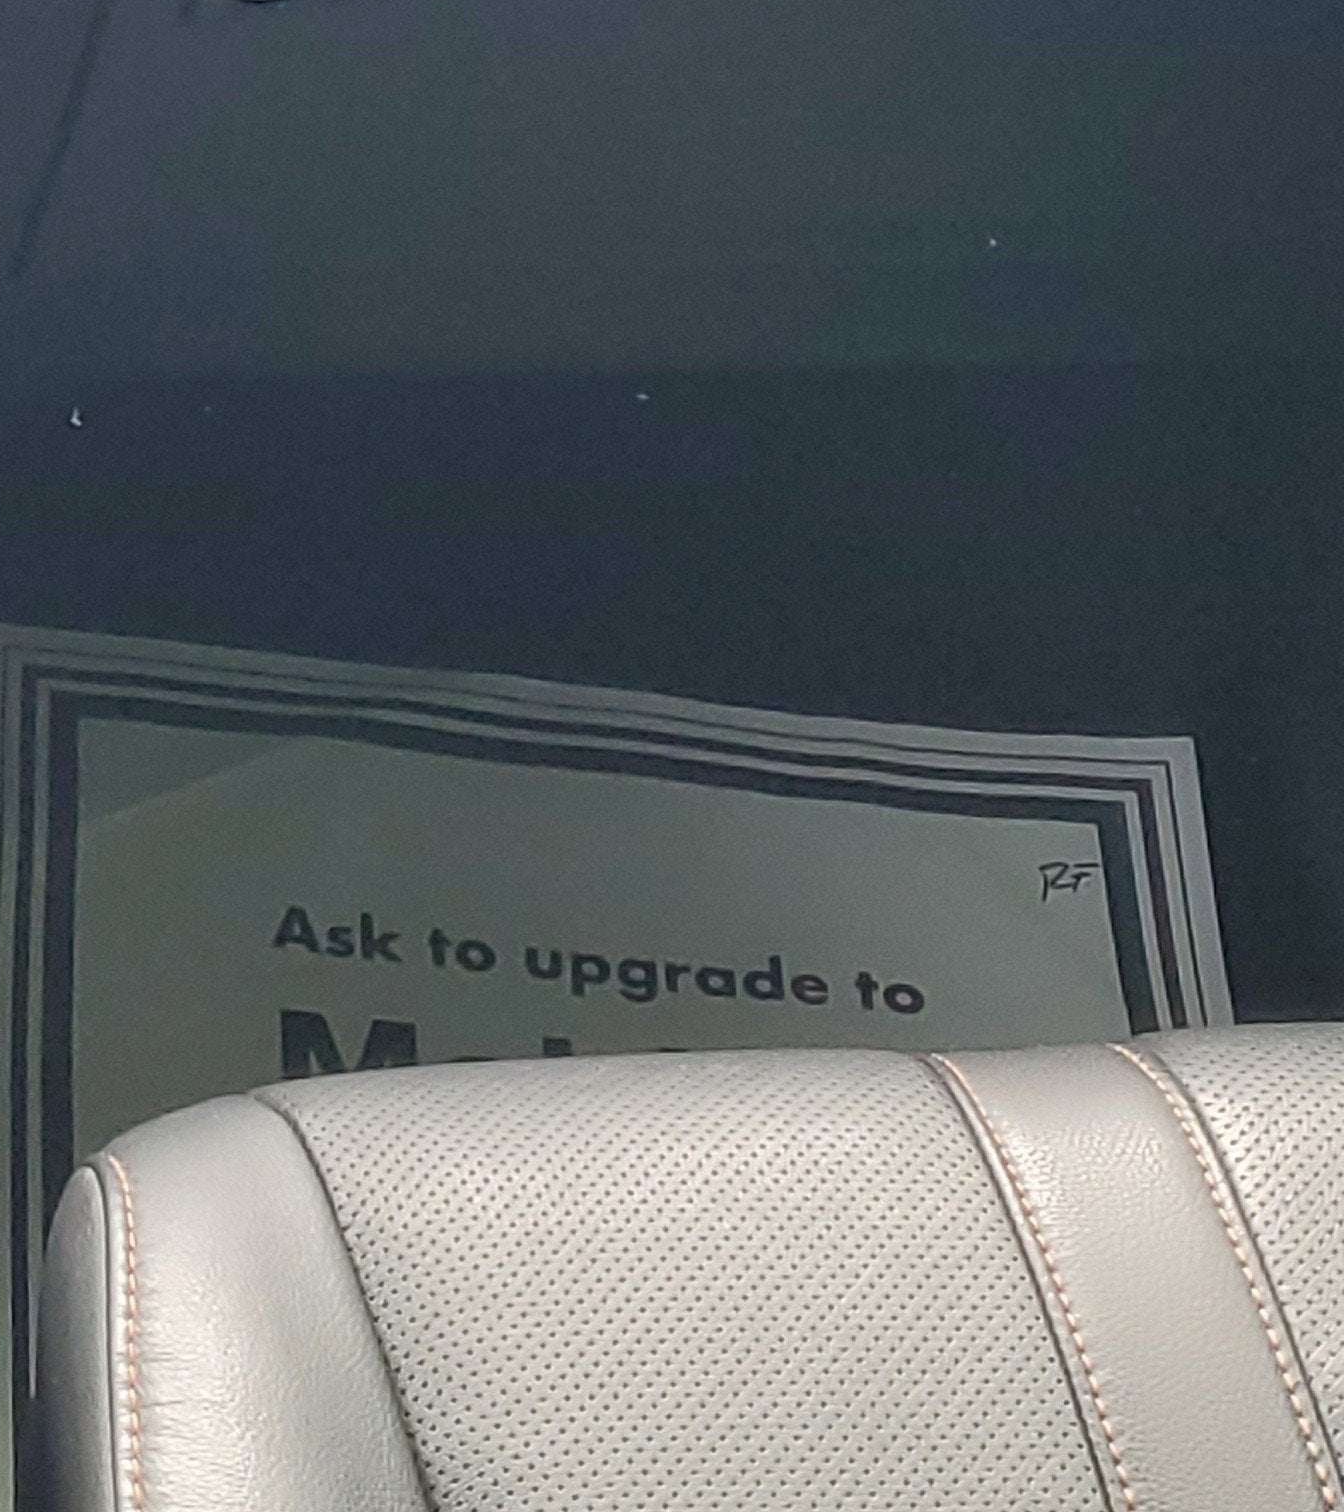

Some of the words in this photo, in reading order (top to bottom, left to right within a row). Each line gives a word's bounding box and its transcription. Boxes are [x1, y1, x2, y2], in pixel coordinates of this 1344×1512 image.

[273, 905, 402, 962] Ask
[429, 927, 496, 971] to
[524, 945, 829, 1003] upgrade
[855, 971, 925, 1014] to
